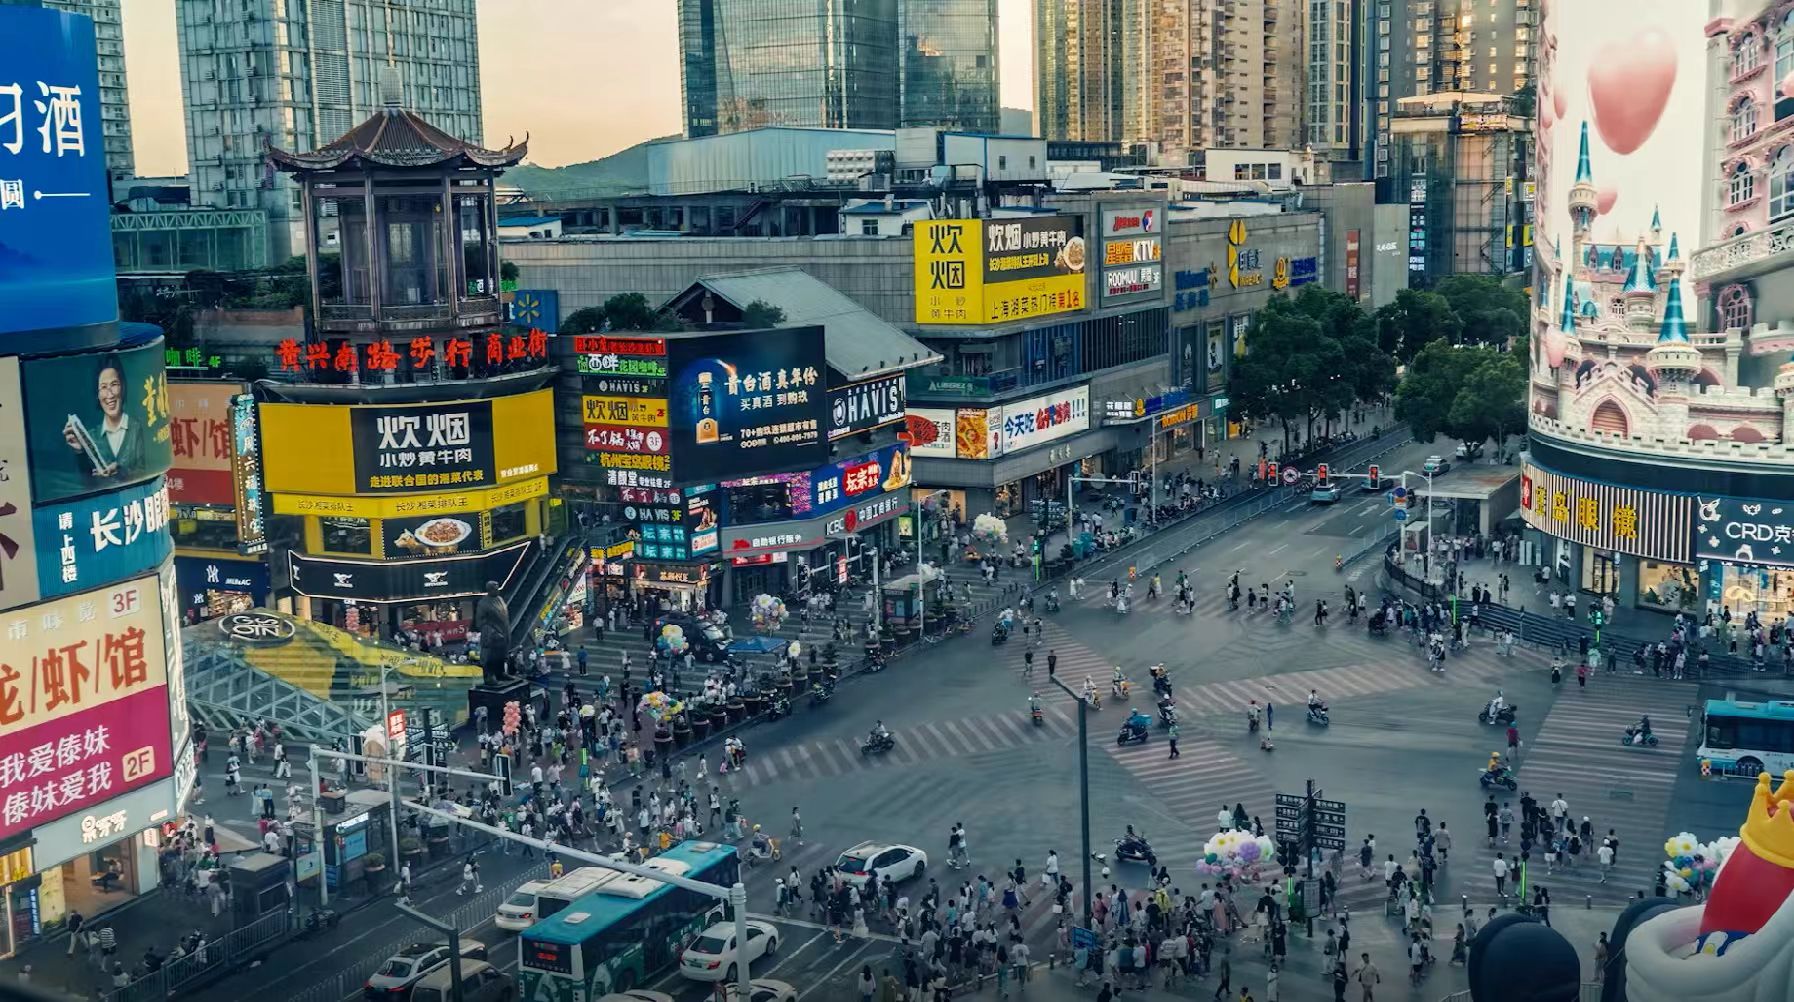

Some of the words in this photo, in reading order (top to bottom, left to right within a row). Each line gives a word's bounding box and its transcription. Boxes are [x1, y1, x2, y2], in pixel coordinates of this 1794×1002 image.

[988, 223, 1021, 252] 炊烟
[586, 399, 628, 421] 炊烟
[847, 385, 898, 423] HAVIS
[376, 412, 470, 450] 炊烟
[379, 448, 472, 468] 小炒黄牛肉
[370, 469, 485, 489] 走进联合国的湘菜代表
[113, 590, 138, 613] 3F
[126, 750, 151, 779] 2F
